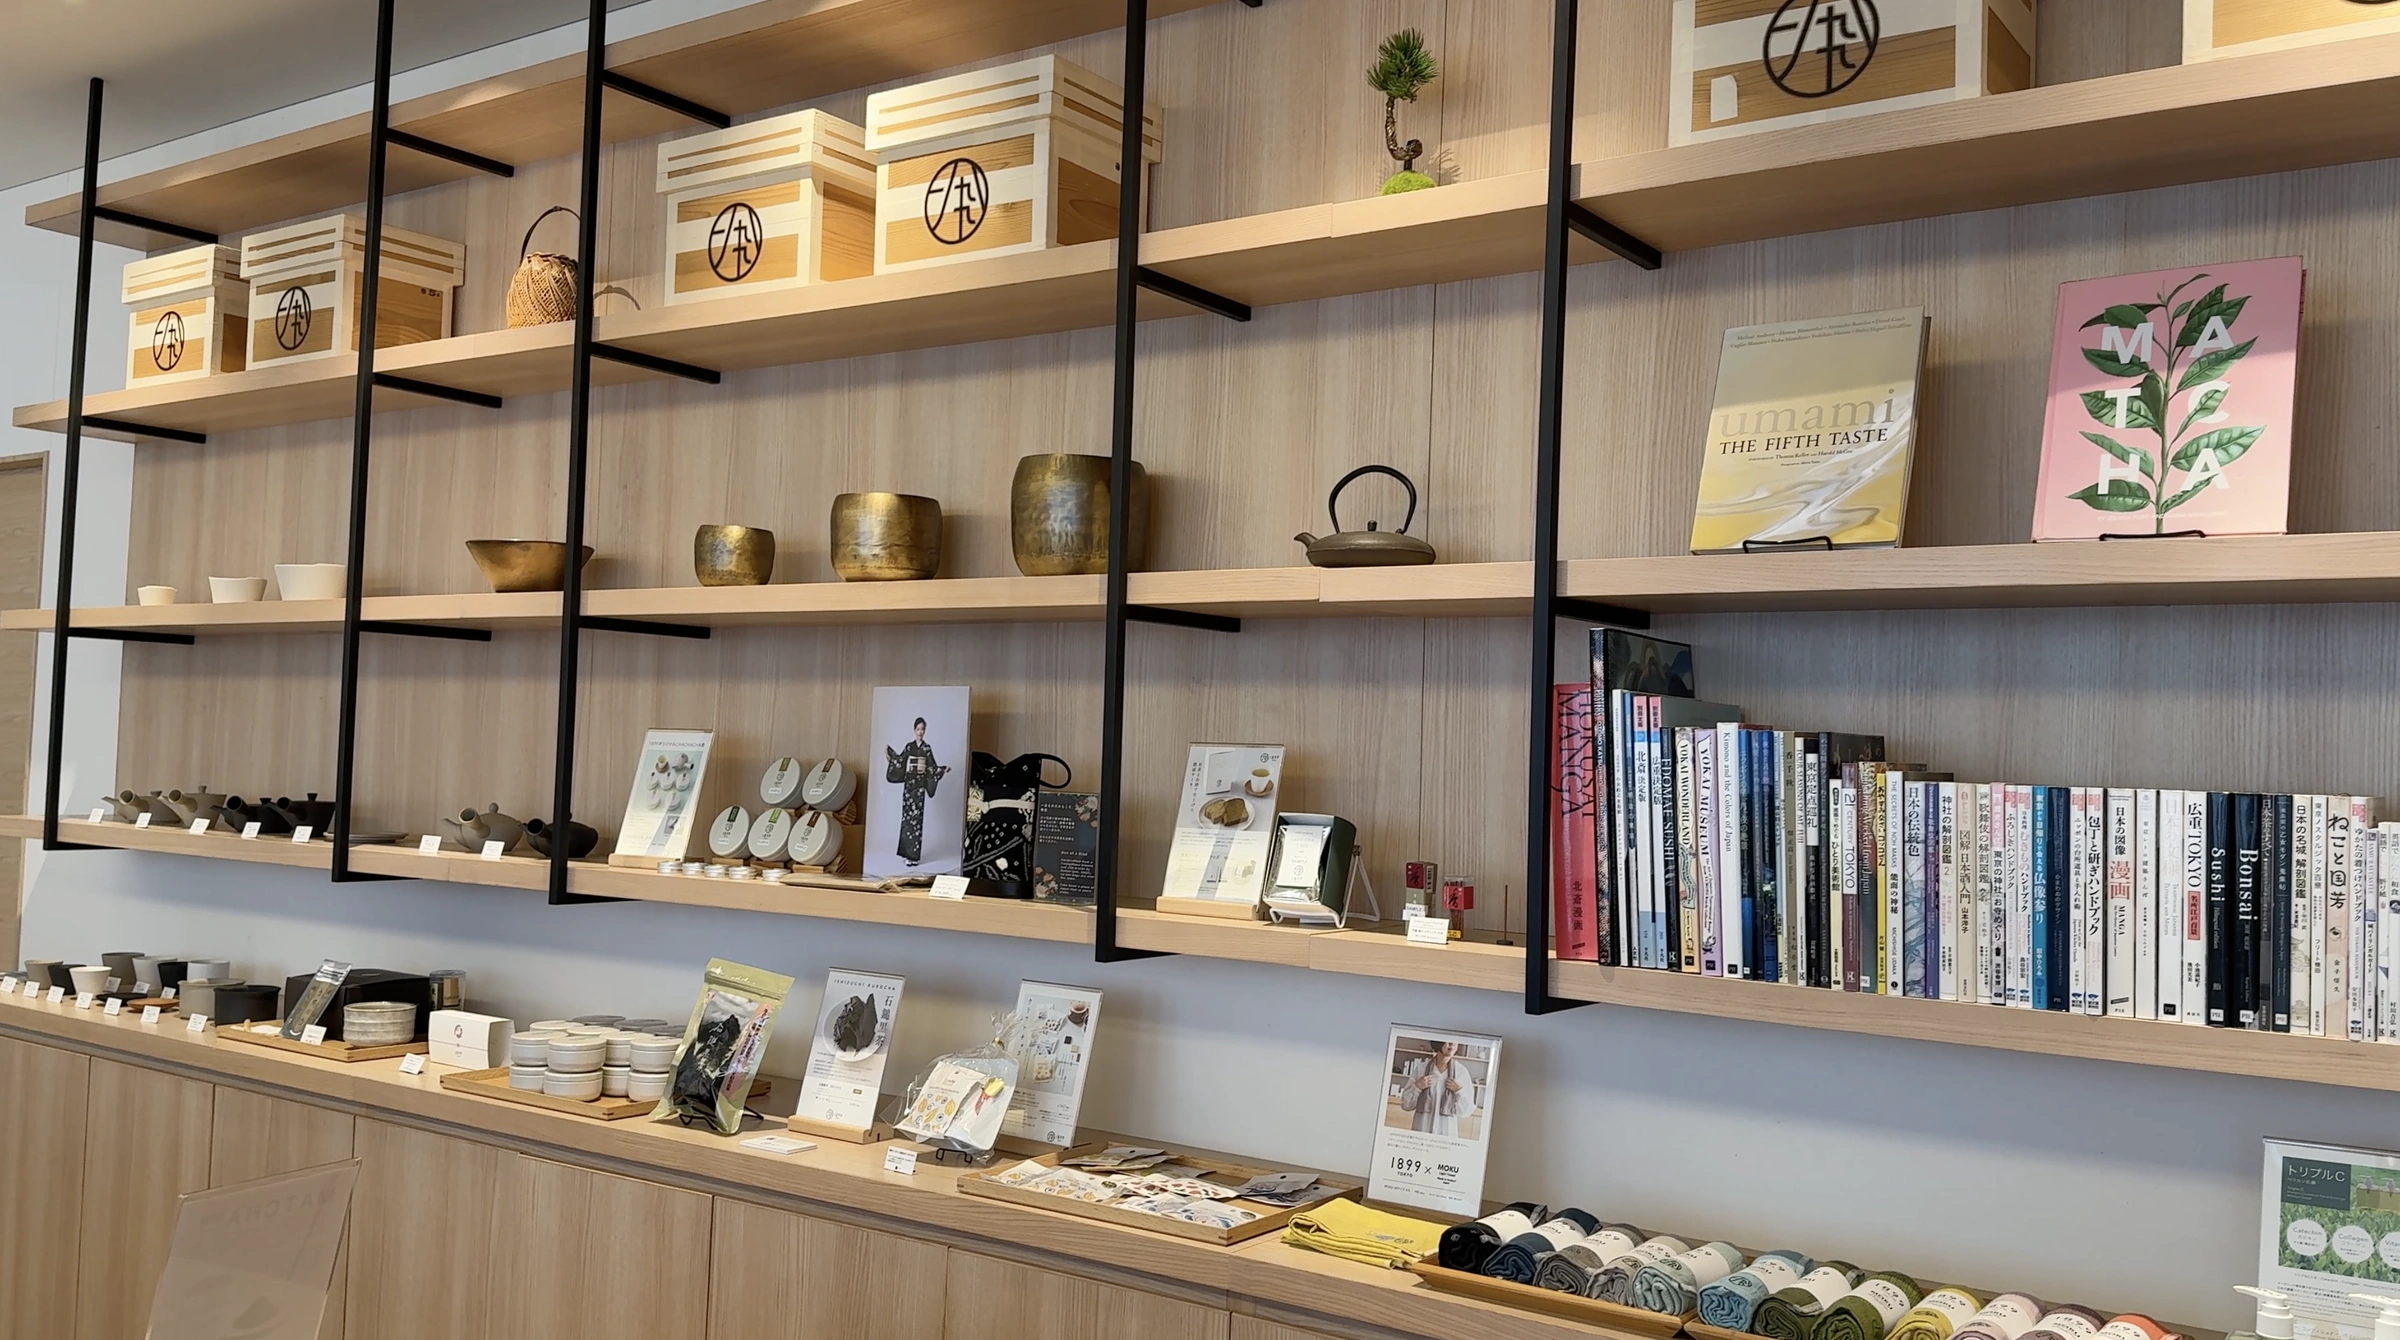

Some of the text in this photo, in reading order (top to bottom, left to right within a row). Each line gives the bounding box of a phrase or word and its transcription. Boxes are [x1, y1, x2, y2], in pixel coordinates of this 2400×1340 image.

[1720, 388, 1895, 438] umami
[1719, 428, 1888, 455] THE FIFTH TASTE
[1551, 690, 1583, 818] MANGA
[1578, 690, 1595, 818] HOKUSAI
[1680, 743, 1689, 775] YOKAI
[1723, 732, 1731, 762] Kimono
[1699, 748, 1711, 856] YOKAI MUSEUM
[1806, 761, 1817, 828] 東京定点巡礼
[1890, 780, 1898, 792] THE
[1890, 794, 1898, 819] SECRETS
[1661, 758, 1675, 861] EDOMAE SUSHI
[1680, 777, 1691, 846] WONDERLAND
[1797, 803, 1803, 812] OF
[1890, 821, 1898, 829] OF
[1907, 787, 1920, 857] 日本の伝統色
[1724, 830, 1733, 852] Japan
[1862, 814, 1871, 845] Wicked
[1890, 832, 1898, 845] NOH
[1942, 796, 1952, 876] 神社の解剖図鑑 2
[1978, 803, 1990, 884] 歌舞伎の解剖図鑑
[1831, 842, 1841, 891] ひとり美術館
[1845, 846, 1855, 889] TOKYO
[1862, 848, 1872, 868] from
[2006, 813, 2016, 890] ふろしきハンドブック
[2020, 831, 2030, 871] むきもの
[2110, 806, 2131, 900] 日本の図像 漫画
[2295, 805, 2307, 899] 日本の名城 解剖図鑑
[2328, 813, 2350, 909] ねこと国芳
[1862, 869, 1872, 895] Japan
[1890, 873, 1899, 914] 能面の神秘
[1960, 853, 1971, 904] 日本酒入門
[2020, 873, 2030, 913] ハンドブック
[2088, 816, 2101, 936] 包丁と研ぎハンドブック
[2211, 847, 2226, 902] Sushi
[2239, 848, 2259, 920] Bonsai
[2353, 828, 2364, 922] ゆかたの着つけハンドブック
[1993, 850, 2003, 942] 東京の神社・お寺めぐり
[1961, 906, 1969, 934] 山本洋子
[2118, 905, 2126, 935] MANGA
[834, 979, 896, 991] ISHIZUCHI KUROCHA
[1391, 1156, 1460, 1174] 1899 MOKU
[2288, 1165, 2346, 1182] トリプルC
[2293, 1227, 2322, 1235] Catechin
[2338, 1233, 2369, 1243] Collagen
